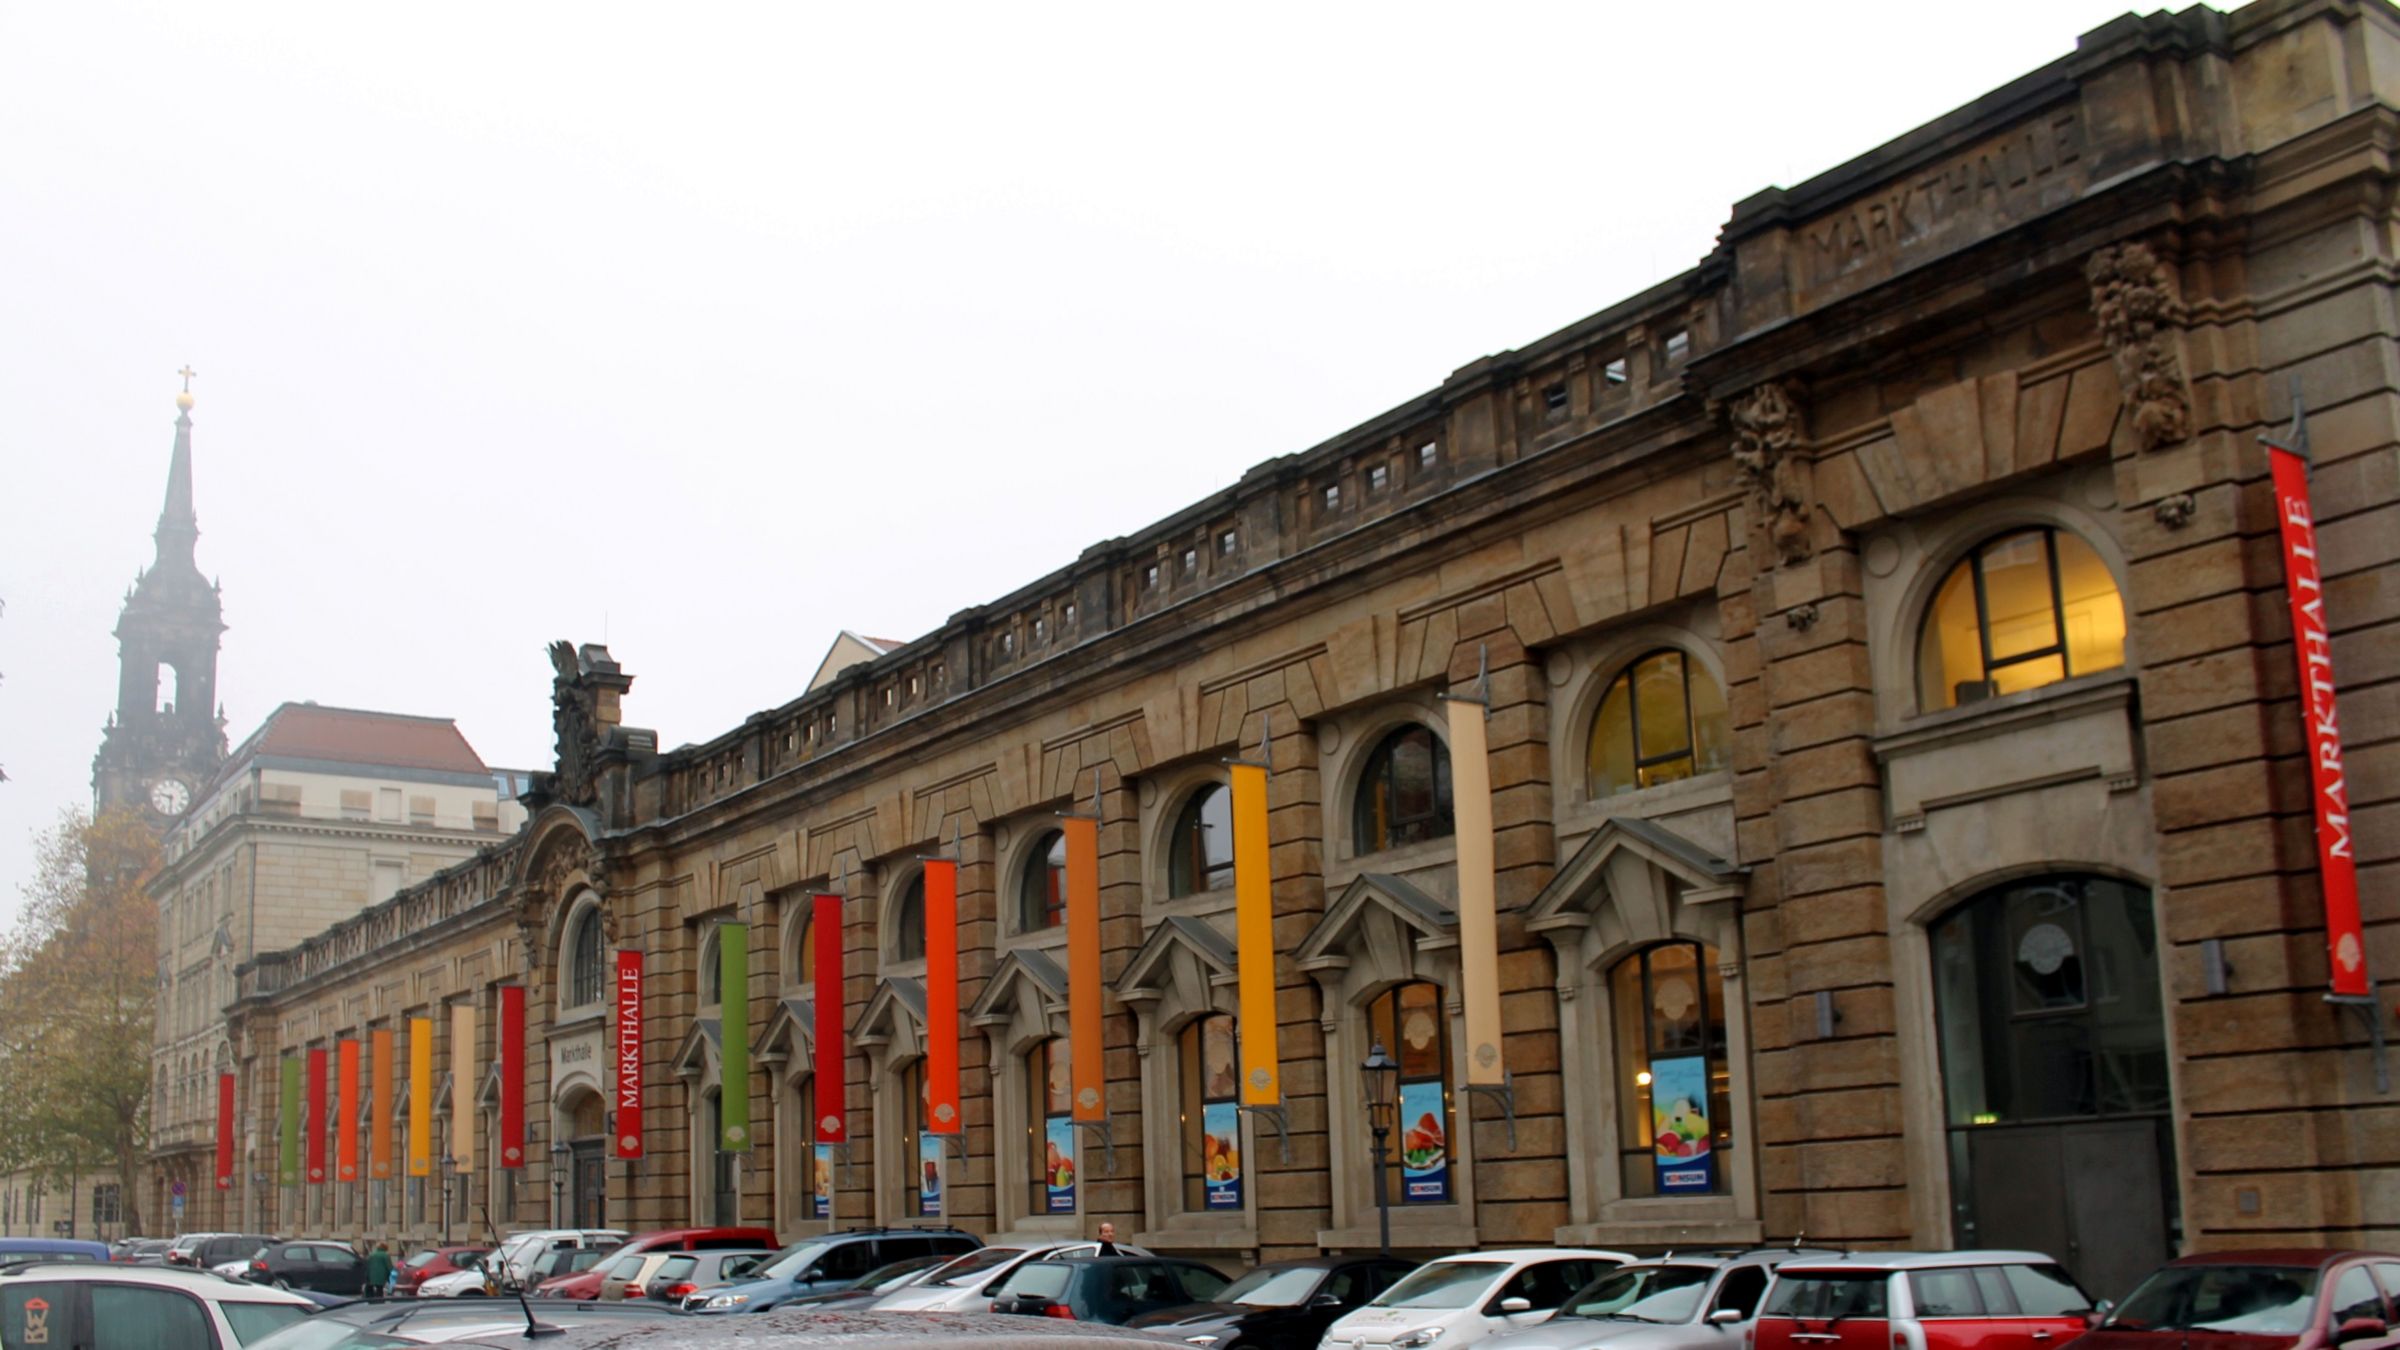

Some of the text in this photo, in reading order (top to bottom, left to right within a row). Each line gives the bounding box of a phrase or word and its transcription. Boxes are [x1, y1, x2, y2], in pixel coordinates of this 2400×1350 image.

[1808, 113, 2081, 268] MARKTHALLE
[2284, 496, 2351, 858] MARKTHALLE
[622, 968, 639, 1108] MARKTHALLE
